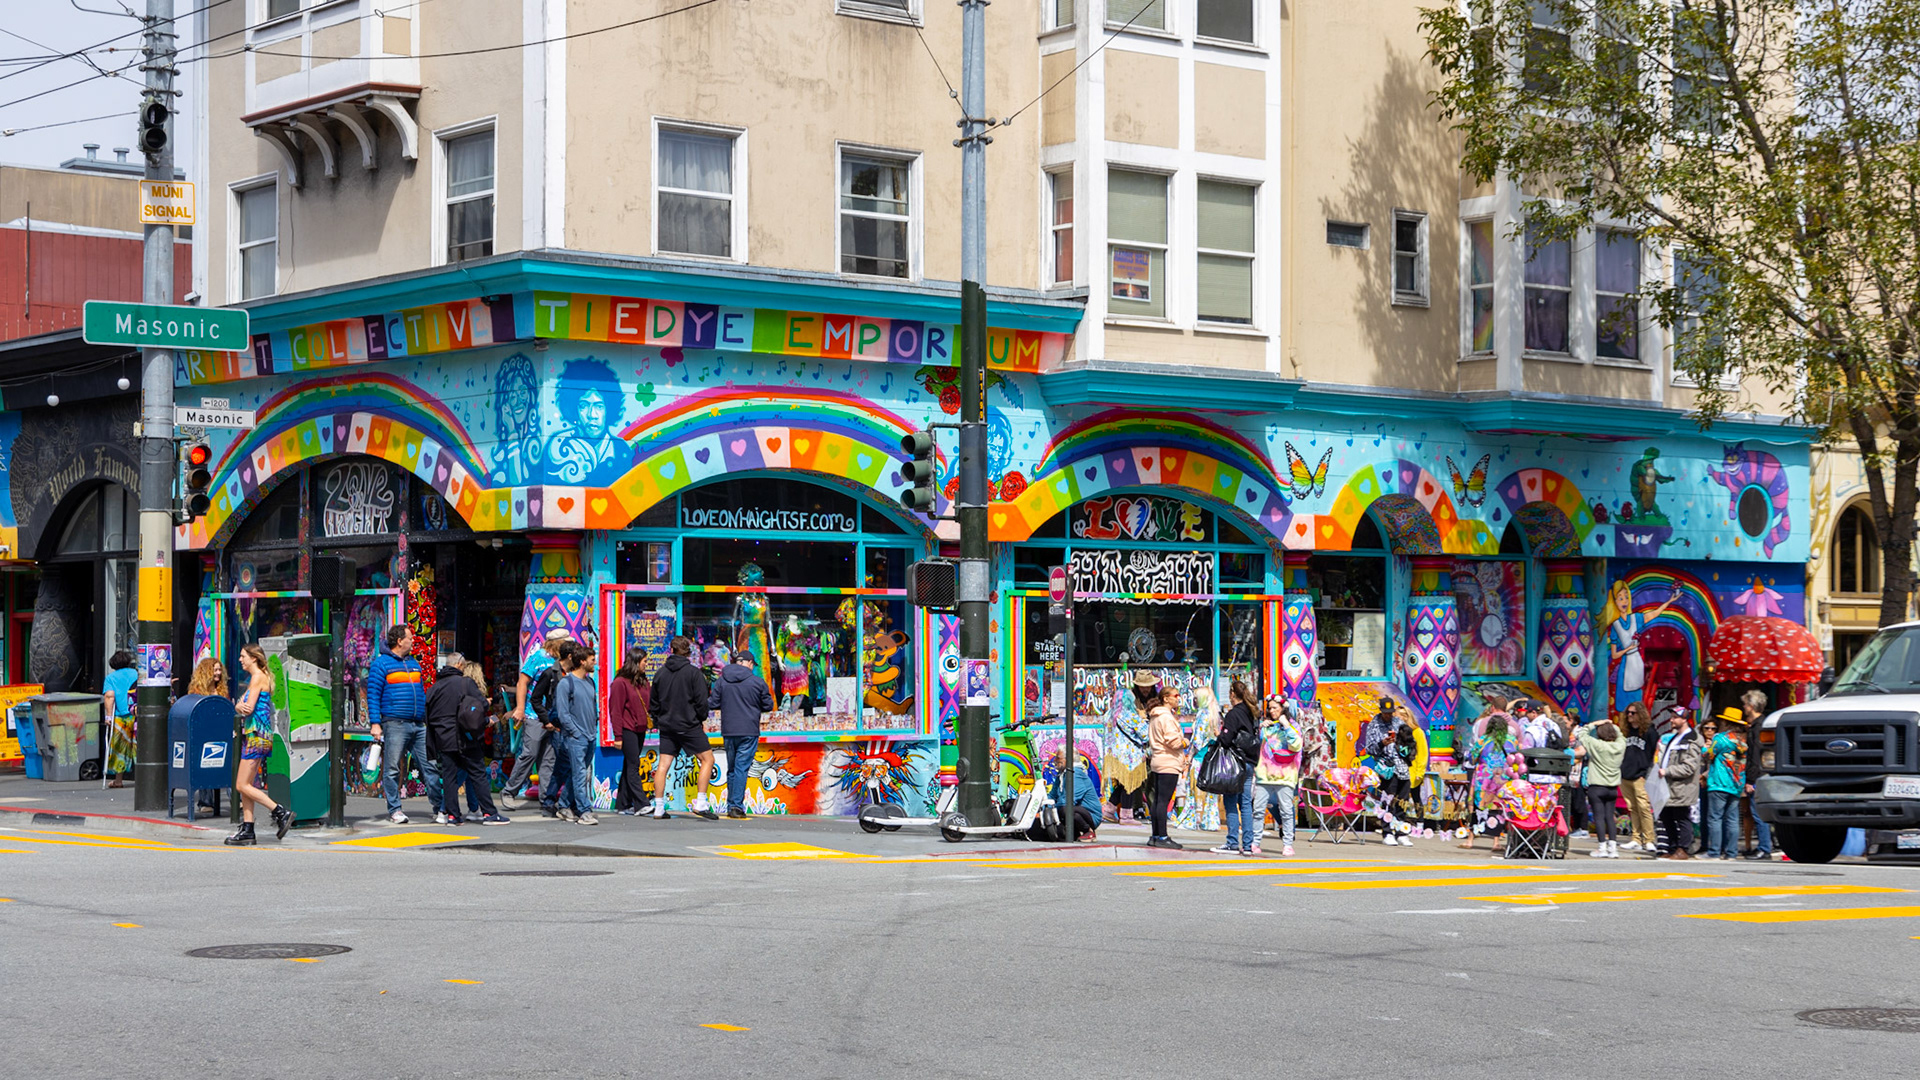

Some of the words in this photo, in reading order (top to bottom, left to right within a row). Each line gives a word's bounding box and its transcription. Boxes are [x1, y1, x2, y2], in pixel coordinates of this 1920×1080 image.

[151, 185, 183, 199] MUNI
[144, 204, 192, 218] SIGNAL
[115, 313, 220, 339] Masonic
[176, 339, 269, 381] ARTIST
[293, 304, 489, 364] COLLECTIVE
[788, 316, 1040, 366] EMPORUM
[210, 400, 228, 408] 1200
[186, 411, 243, 425] Masonic
[49, 452, 86, 506] World
[631, 618, 653, 628] LOVE
[654, 618, 667, 628] ON
[633, 628, 667, 637] HAIGHT
[1039, 652, 1060, 661] HERE
[1044, 661, 1055, 670] SF
[1160, 667, 1182, 689] this
